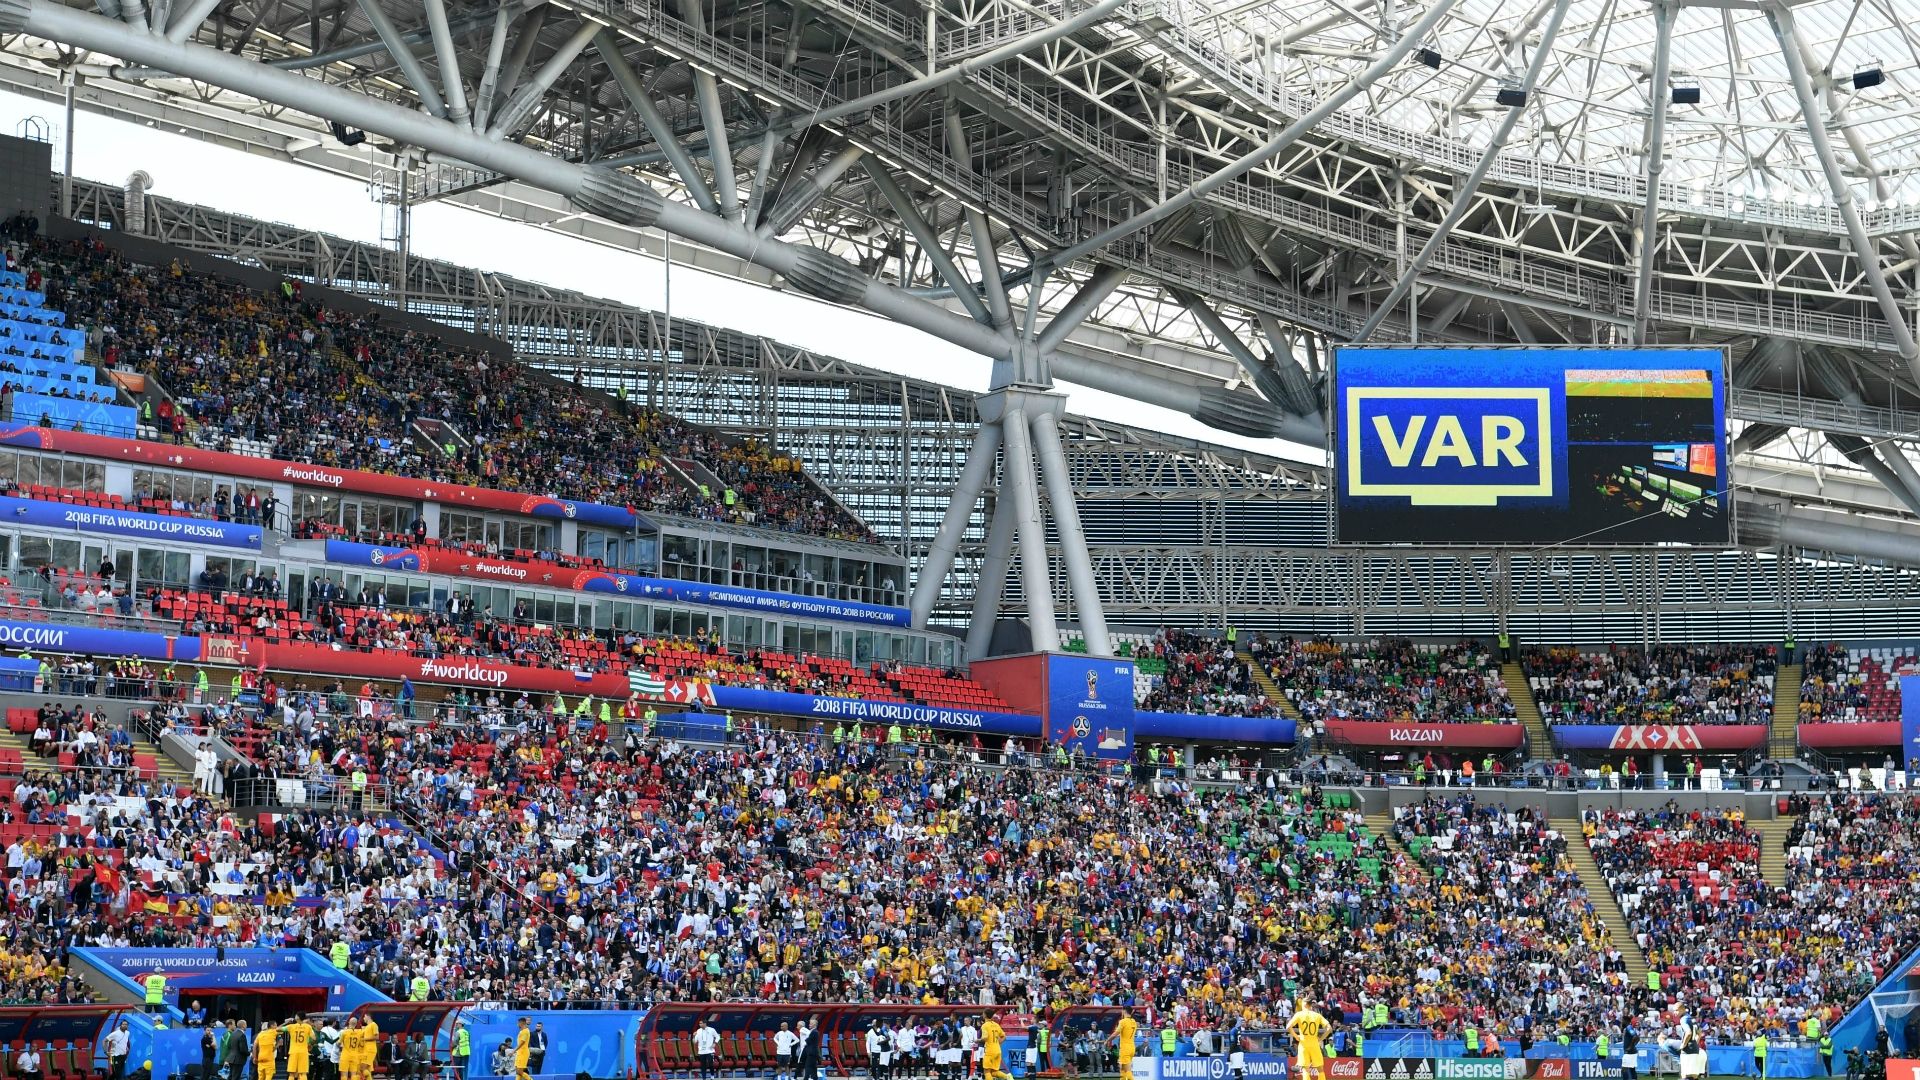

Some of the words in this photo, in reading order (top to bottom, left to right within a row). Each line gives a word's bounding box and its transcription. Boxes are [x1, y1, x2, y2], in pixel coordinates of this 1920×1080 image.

[1372, 415, 1528, 467] VAR
[283, 466, 342, 487] #worldcup
[65, 511, 90, 523] 2018
[92, 514, 116, 527] FIFA
[118, 517, 158, 531] WORLD
[159, 521, 182, 533] CUP
[184, 524, 224, 538] RUSSIA
[476, 562, 527, 579] #worldcup
[757, 597, 778, 607] МИРА
[791, 601, 825, 612] ФУТБОЛУ
[826, 605, 841, 615] FIFA
[842, 607, 858, 617] 2018
[859, 609, 865, 618] В
[421, 659, 508, 687] #worldcup
[1114, 667, 1129, 675] FIFA
[813, 698, 841, 713] 2018
[842, 701, 868, 716] FIFA
[870, 704, 912, 720] WORLD
[913, 709, 937, 723] CUP
[940, 711, 982, 727] RUSSIA
[1390, 728, 1443, 741] KAZAN
[122, 958, 142, 967] 2018
[144, 958, 162, 967] FIFA
[164, 958, 196, 967] WORLD
[196, 958, 213, 967] CUP
[237, 972, 276, 983] KAZAN
[1301, 1021, 1316, 1036] 20
[295, 1031, 304, 1043] 15
[349, 1036, 357, 1048] 13
[1163, 1060, 1207, 1077] GAZPROM
[1248, 1062, 1286, 1075] WANDA
[1437, 1059, 1502, 1078] Hisense
[1541, 1063, 1564, 1077] Bud
[1365, 1072, 1386, 1080] adidas
[1390, 1072, 1410, 1080] adidas
[1414, 1072, 1433, 1080] adidas
